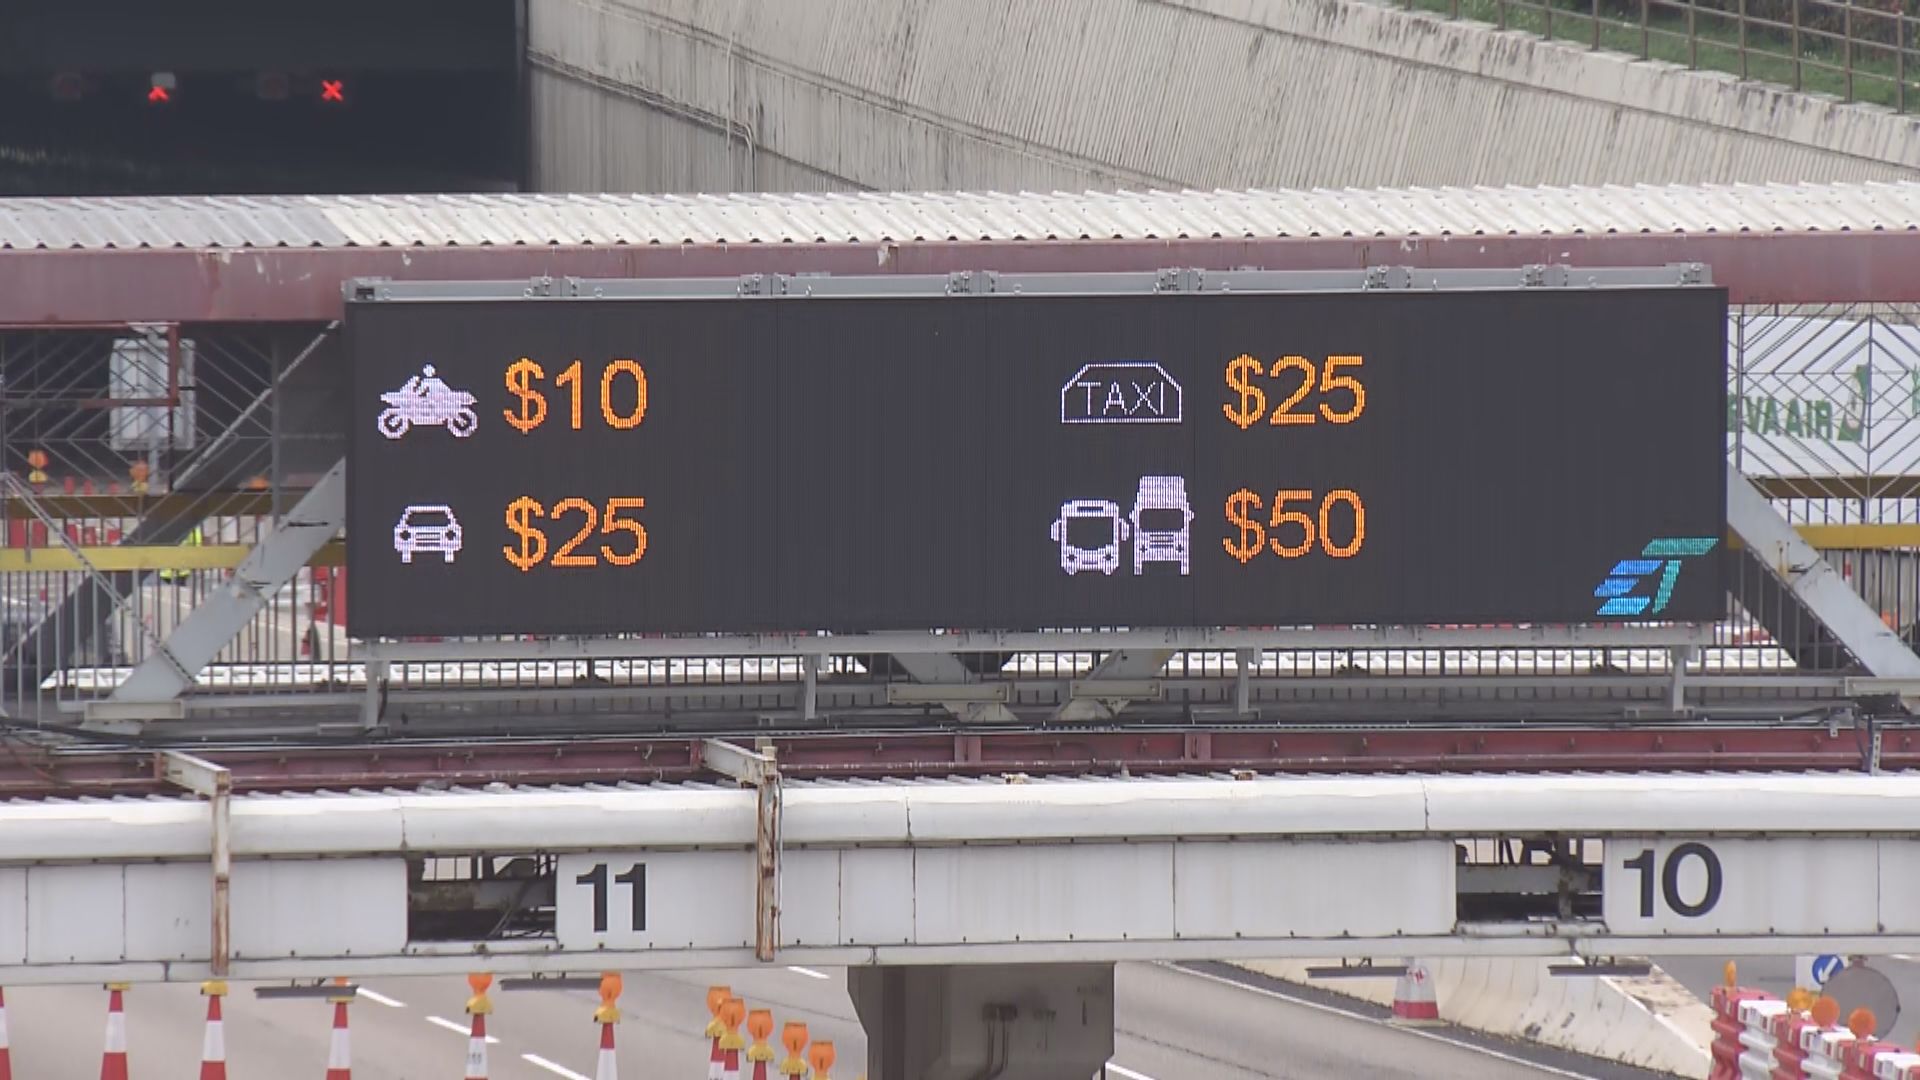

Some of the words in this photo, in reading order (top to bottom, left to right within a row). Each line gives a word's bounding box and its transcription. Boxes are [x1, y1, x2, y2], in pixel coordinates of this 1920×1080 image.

[503, 357, 647, 435] $10
[1077, 382, 1164, 415] TAXI
[1223, 354, 1365, 429] $25
[503, 496, 647, 571] $25
[1222, 488, 1365, 563] $50
[576, 863, 646, 932] 11
[1623, 842, 1723, 917] 10
